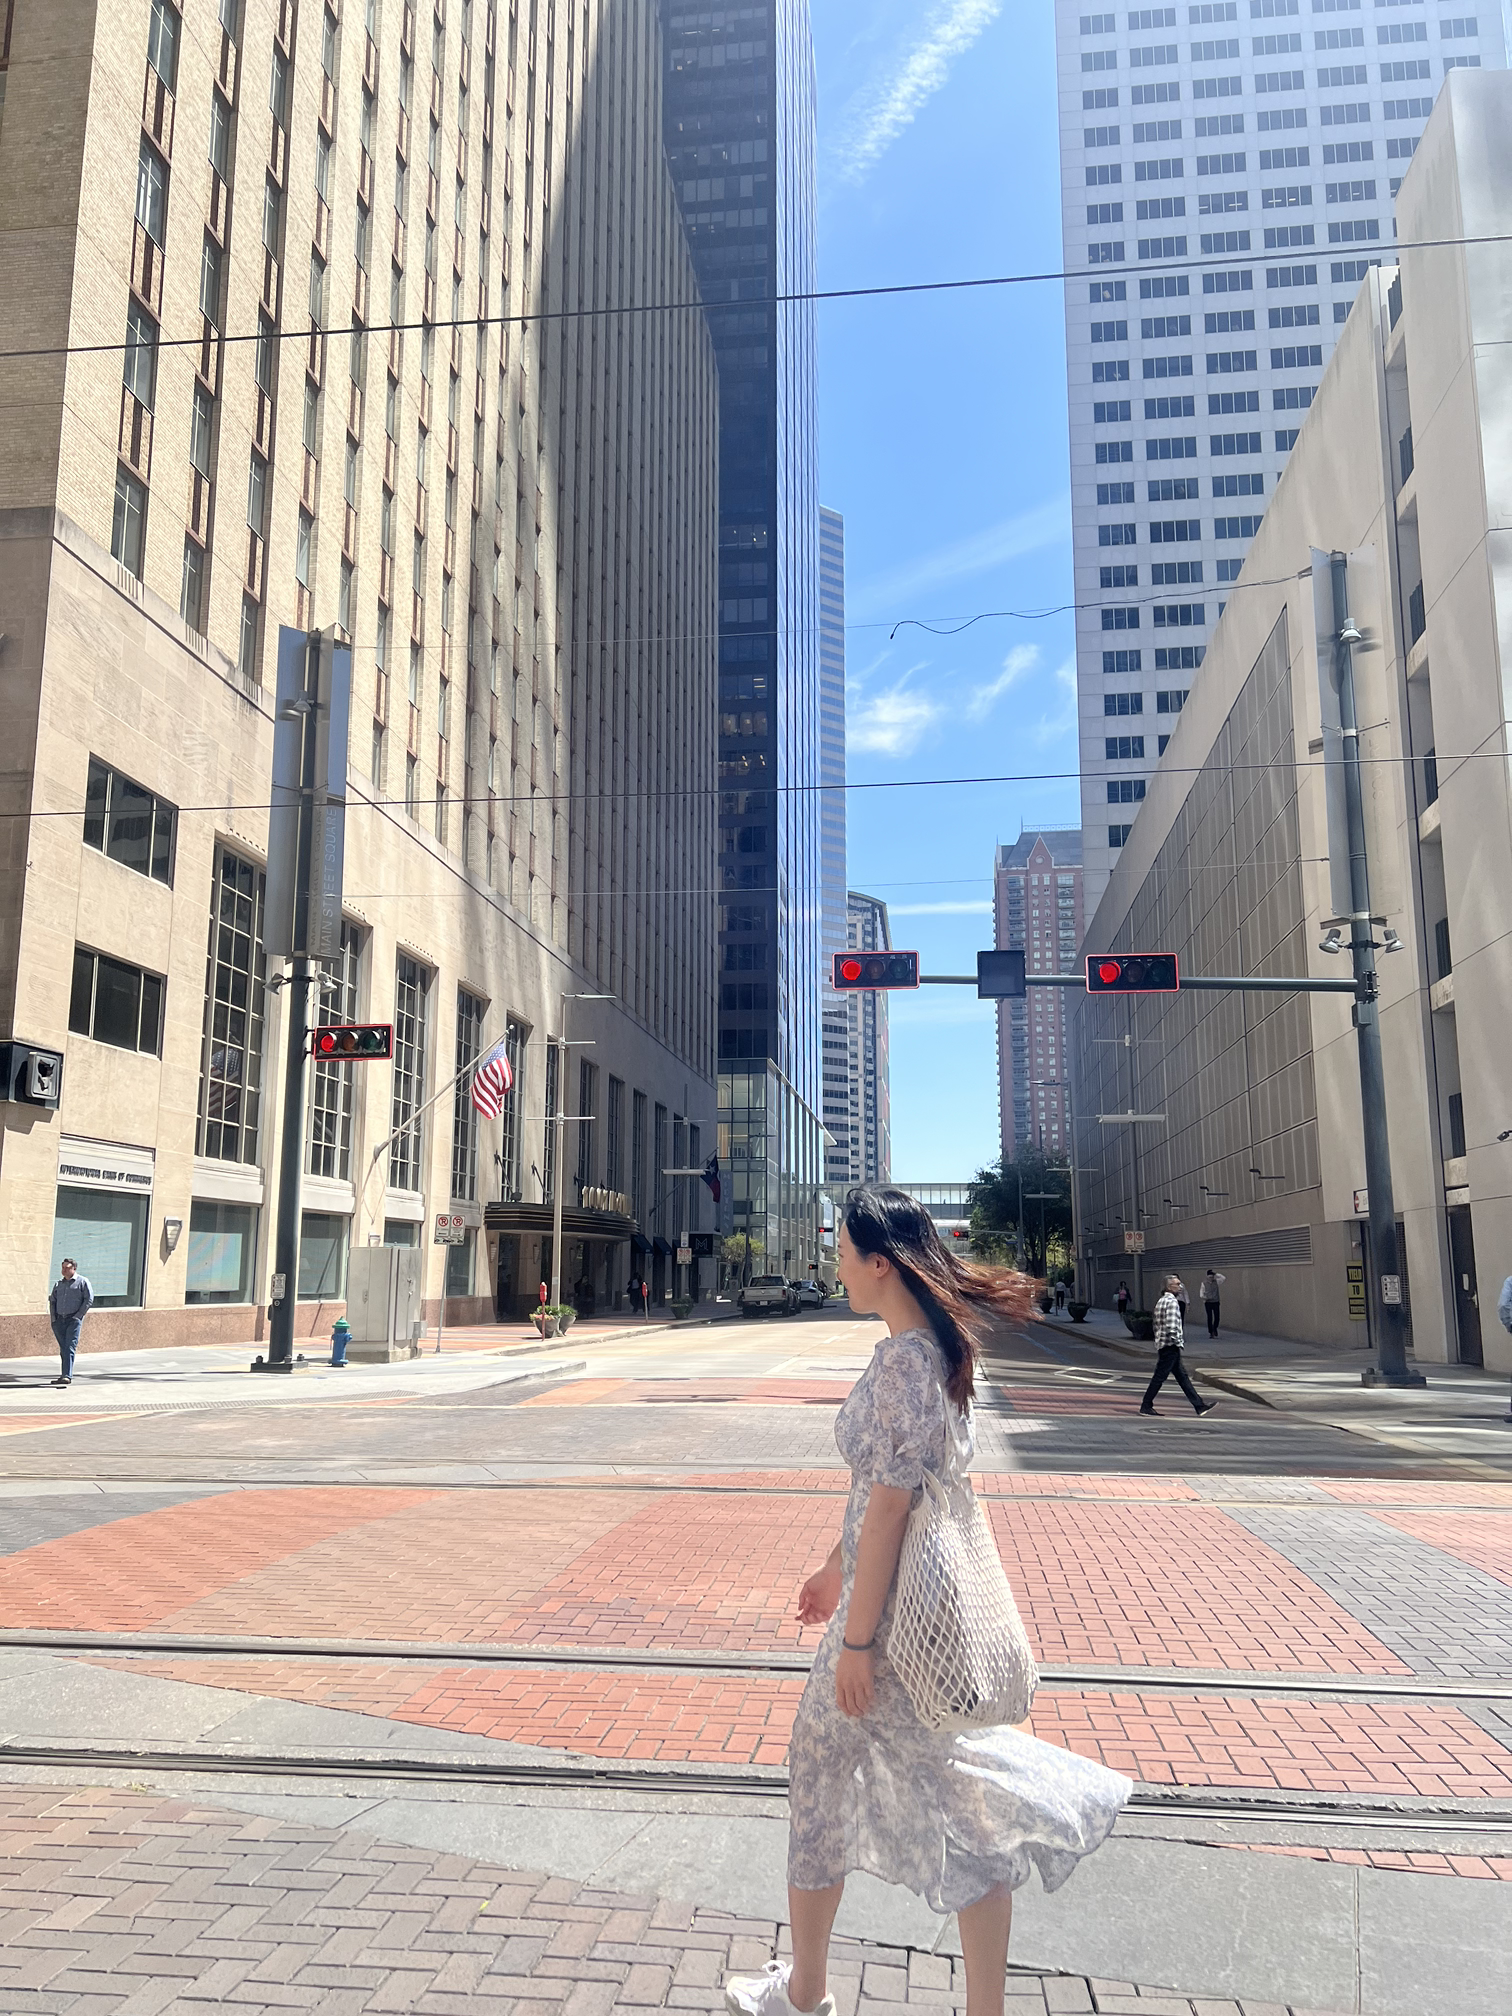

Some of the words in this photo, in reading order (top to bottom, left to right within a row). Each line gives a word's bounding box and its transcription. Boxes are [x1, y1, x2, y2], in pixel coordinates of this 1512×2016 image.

[325, 807, 337, 863] SQUARE
[322, 865, 335, 918] STREET
[321, 920, 333, 955] MAIN
[695, 1237, 708, 1250] M
[1352, 1285, 1360, 1295] TO
